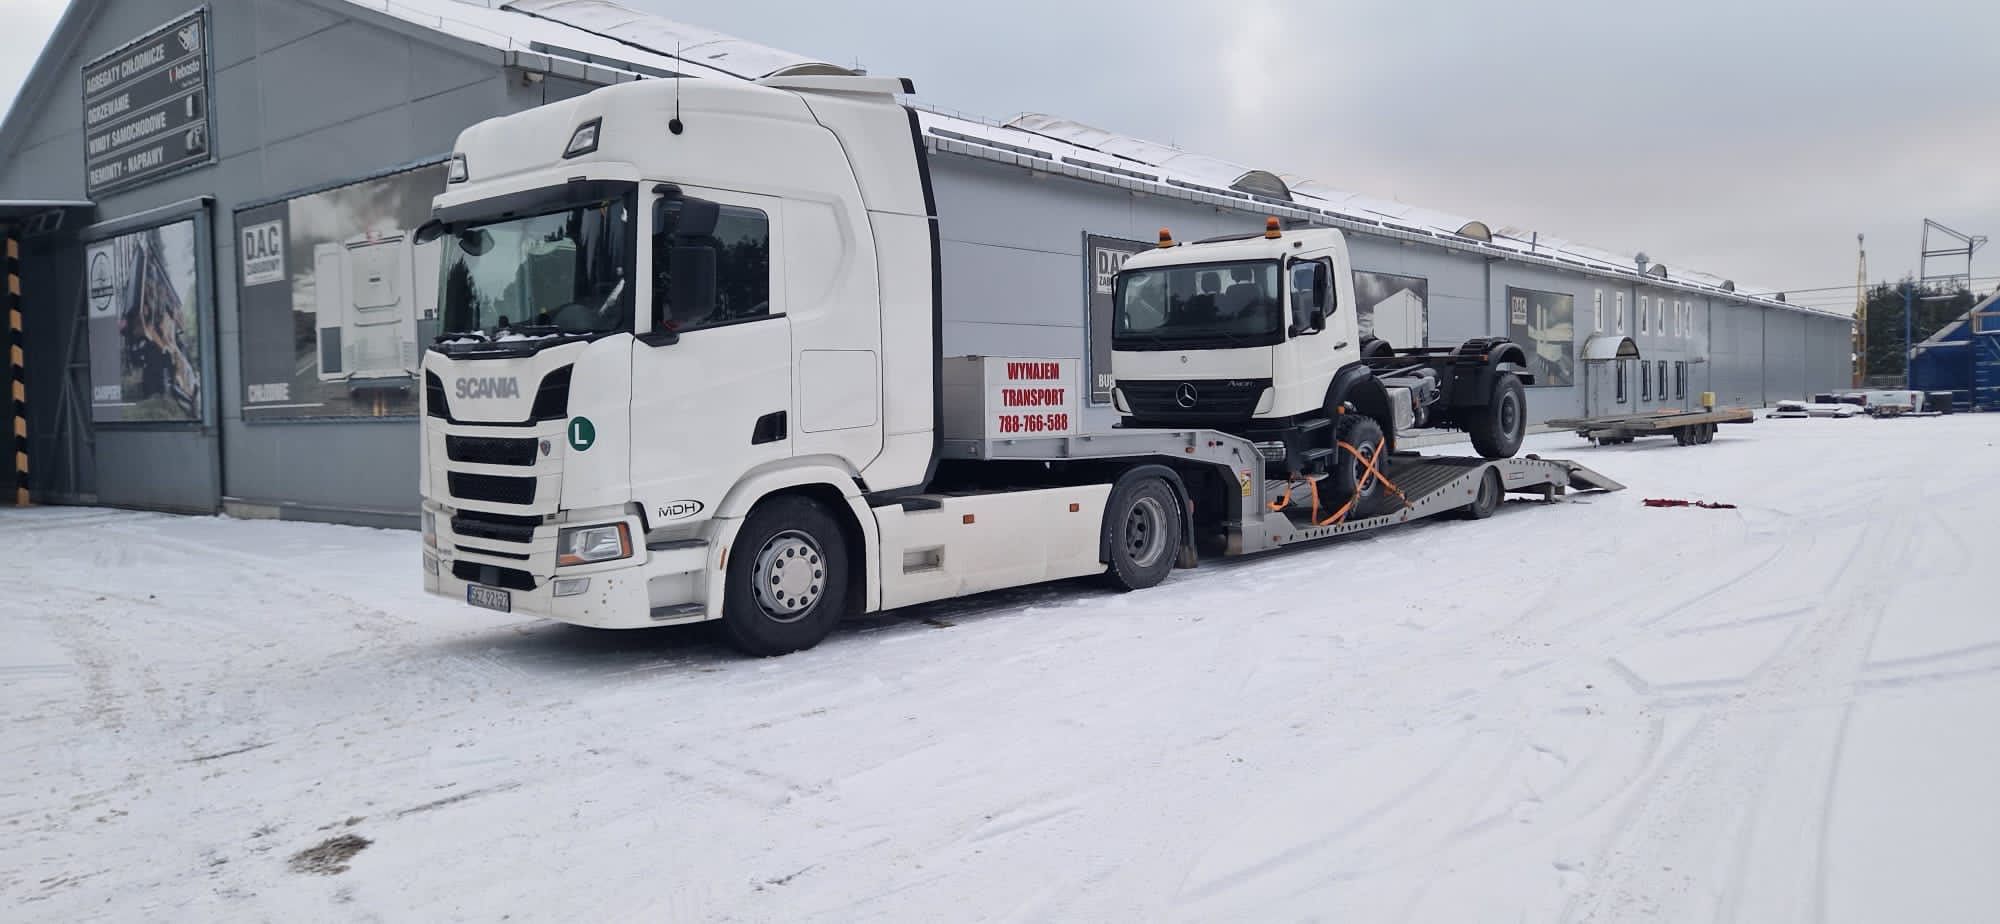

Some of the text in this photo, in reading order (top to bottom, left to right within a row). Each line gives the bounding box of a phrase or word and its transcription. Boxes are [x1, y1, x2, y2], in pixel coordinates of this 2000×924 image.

[87, 43, 165, 95] AGREGATY CHŁODNICZE
[88, 93, 130, 125] OGRZEWANIE
[89, 111, 166, 155] WINDY SAMOCHODOWE
[90, 161, 122, 185] REMONTY
[128, 145, 163, 173] NAPRAWY
[1008, 362, 1060, 380] WYNAJEM
[455, 377, 520, 399] SCANIA
[1002, 388, 1065, 407] TRANSPORT
[574, 423, 588, 445] L
[998, 413, 1068, 433] 788-766-588
[658, 503, 697, 518] MDH
